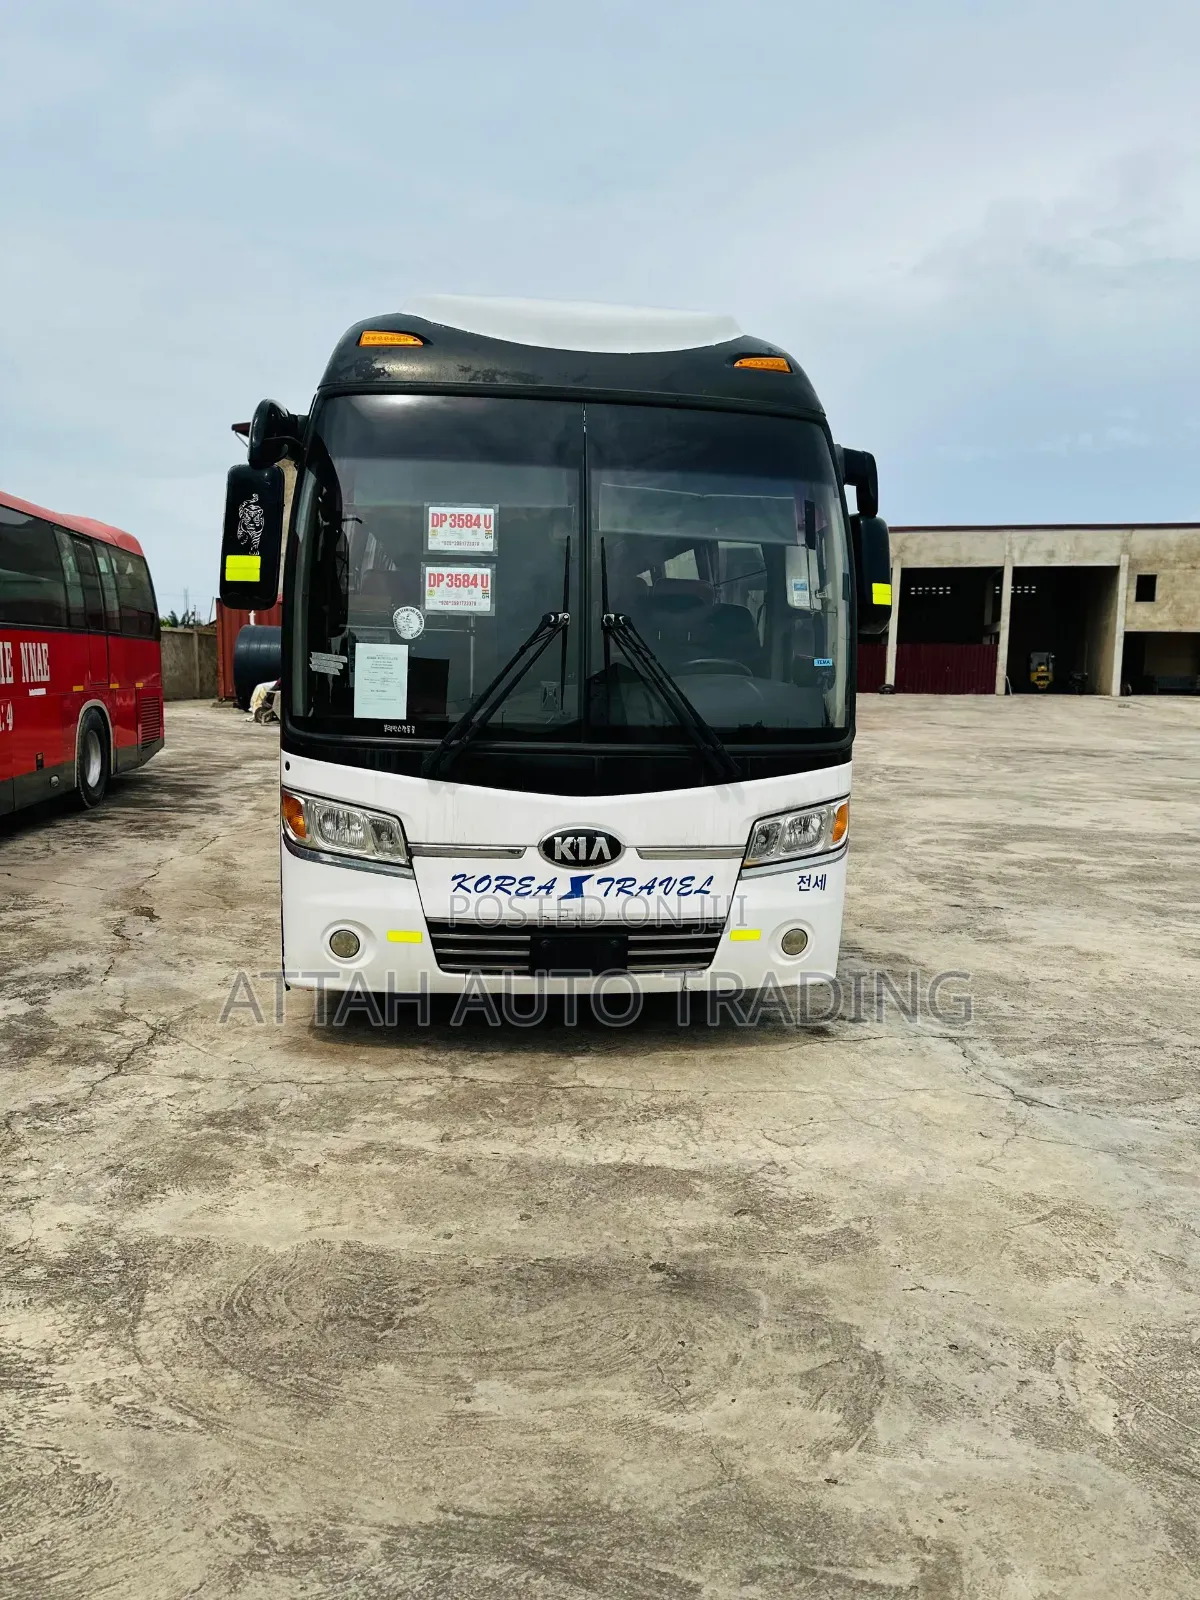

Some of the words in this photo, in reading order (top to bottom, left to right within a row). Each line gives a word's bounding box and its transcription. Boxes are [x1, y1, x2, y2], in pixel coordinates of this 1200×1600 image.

[431, 513, 448, 528] DP
[449, 514, 481, 528] 3584
[484, 514, 492, 529] U
[428, 572, 444, 587] DP
[446, 573, 478, 588] 3584
[481, 574, 488, 588] U
[554, 836, 612, 860] KIA
[451, 874, 558, 896] KOREA
[596, 875, 714, 897] TRAVEL
[797, 874, 826, 891] 전세
